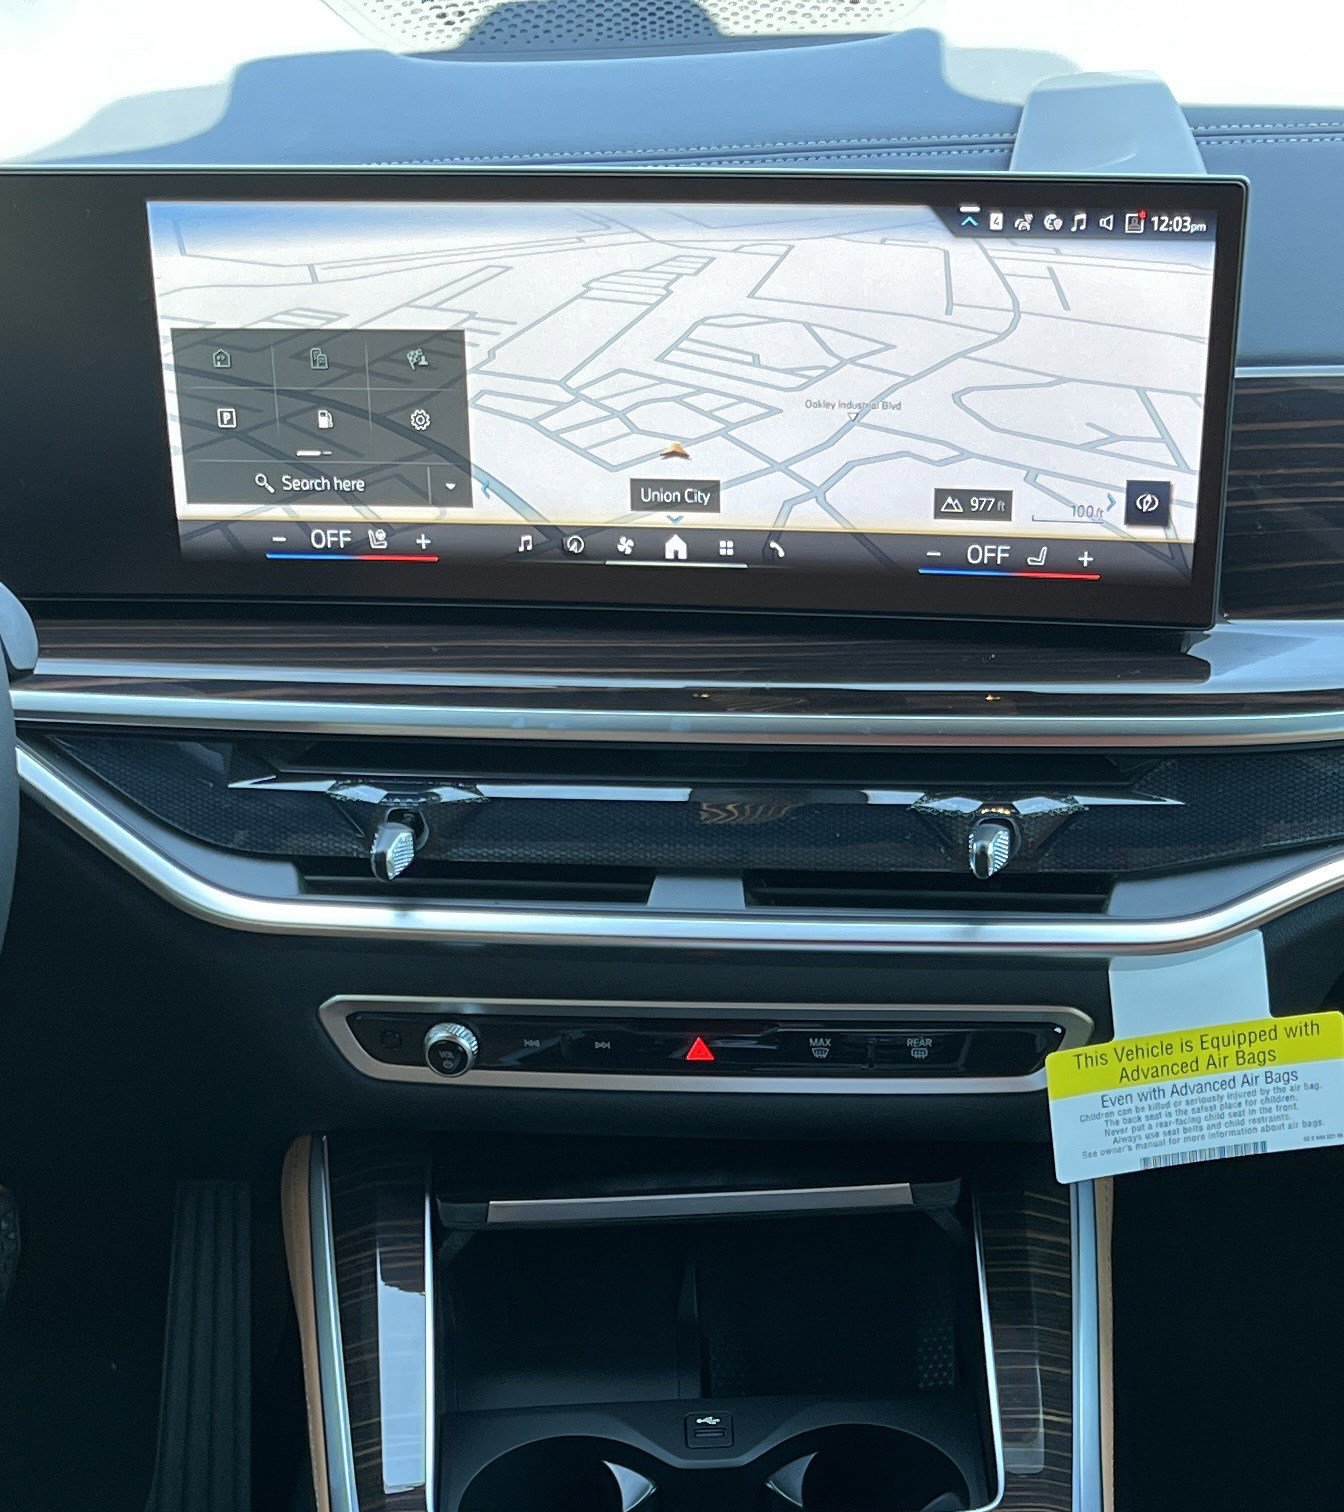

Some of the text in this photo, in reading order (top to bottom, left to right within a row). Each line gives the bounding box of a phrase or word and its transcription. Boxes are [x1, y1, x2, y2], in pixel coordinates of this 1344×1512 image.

[1150, 215, 1207, 233] 12:03pm
[804, 399, 836, 410] Oakley
[881, 401, 902, 410] Blvd
[281, 475, 365, 492] Search here
[640, 486, 711, 506] Union City
[970, 496, 1006, 512] 977 ft
[1070, 504, 1093, 518] 100
[310, 528, 352, 549] OFF
[966, 544, 1011, 565] OFF
[808, 1037, 832, 1047] MAX
[906, 1037, 933, 1047] REAR
[1073, 1020, 1320, 1070] This Vehicle is Equipped with
[1118, 1049, 1277, 1083] Advanced Air Bags
[1100, 1069, 1299, 1109] Even with Advanced Air Bags
[1079, 1111, 1115, 1123] Children
[1117, 1108, 1133, 1117] can
[1135, 1104, 1145, 1114] be
[1147, 1100, 1171, 1111] killed
[1173, 1100, 1182, 1108] or
[1185, 1090, 1224, 1105] seriously
[1226, 1088, 1257, 1100] injured
[1259, 1087, 1270, 1096] by
[1273, 1085, 1287, 1093] the
[1289, 1083, 1301, 1092] air
[1104, 1118, 1120, 1128] The
[1122, 1115, 1142, 1125] back
[1144, 1111, 1163, 1121] seat
[1164, 1110, 1173, 1118] is
[1175, 1107, 1189, 1116] the
[1191, 1103, 1217, 1115] safest
[1219, 1100, 1243, 1112] place
[1245, 1098, 1258, 1107] for
[1104, 1127, 1129, 1137] Never
[1131, 1123, 1146, 1135] put
[1204, 1111, 1225, 1121] child
[1227, 1108, 1246, 1119] seat
[1248, 1107, 1257, 1116] in
[1259, 1105, 1273, 1114] the
[1112, 1135, 1143, 1146] Always
[1144, 1131, 1160, 1140] use
[1162, 1127, 1180, 1137] seat
[1182, 1124, 1204, 1134] belts
[1206, 1120, 1222, 1131] and
[1224, 1117, 1246, 1127] child
[1082, 1149, 1098, 1159] See
[1135, 1137, 1166, 1150] manual
[1168, 1136, 1181, 1146] for
[1183, 1133, 1206, 1143] more
[1208, 1125, 1258, 1141] information
[1260, 1121, 1286, 1133] about
[1287, 1120, 1300, 1130] air
